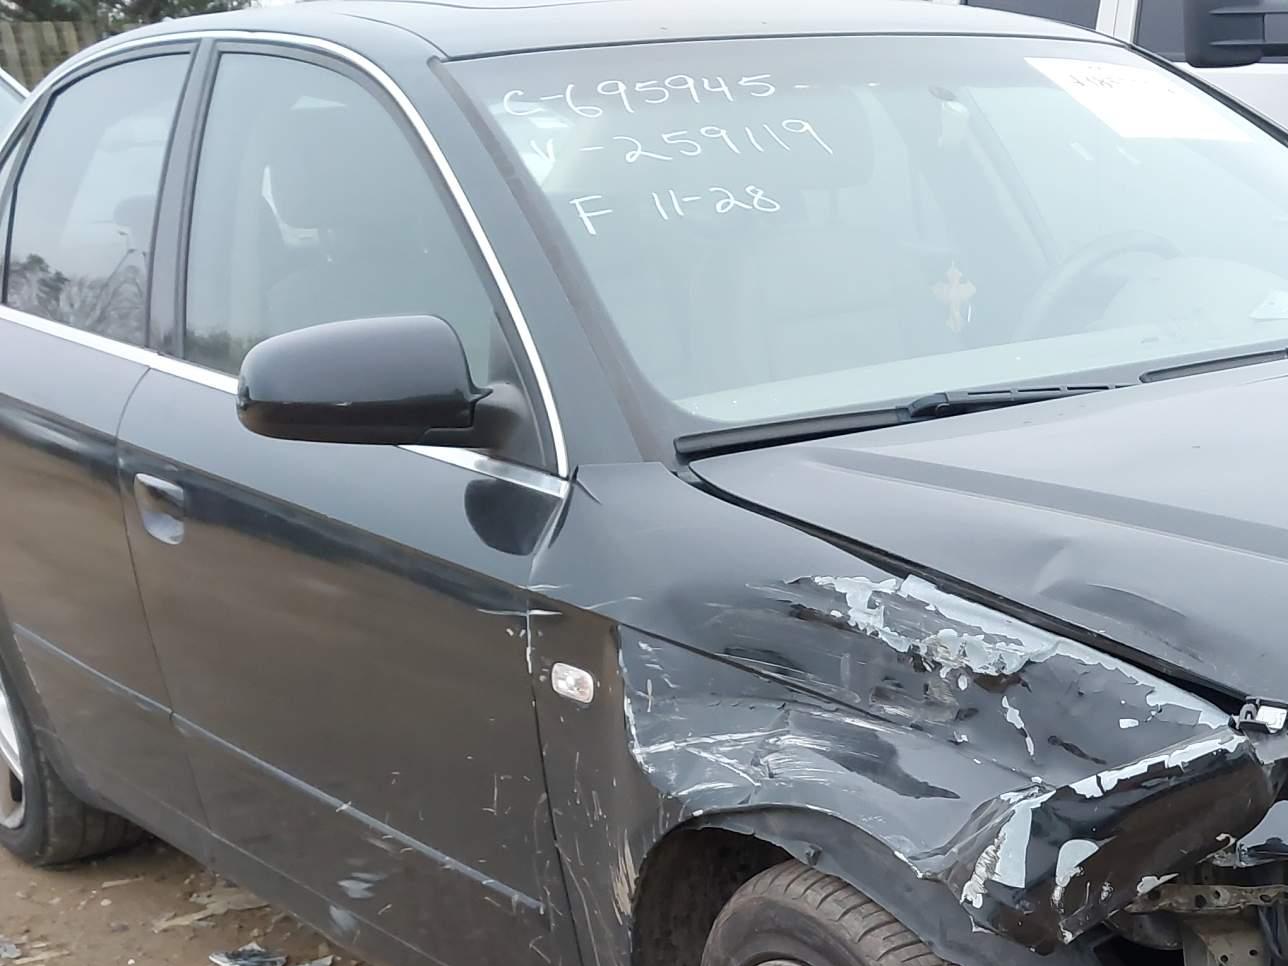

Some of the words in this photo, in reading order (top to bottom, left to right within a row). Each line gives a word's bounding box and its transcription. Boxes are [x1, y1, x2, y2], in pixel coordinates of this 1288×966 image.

[503, 74, 776, 118] C-695945
[569, 195, 613, 235] F
[651, 184, 781, 221] 11-28
